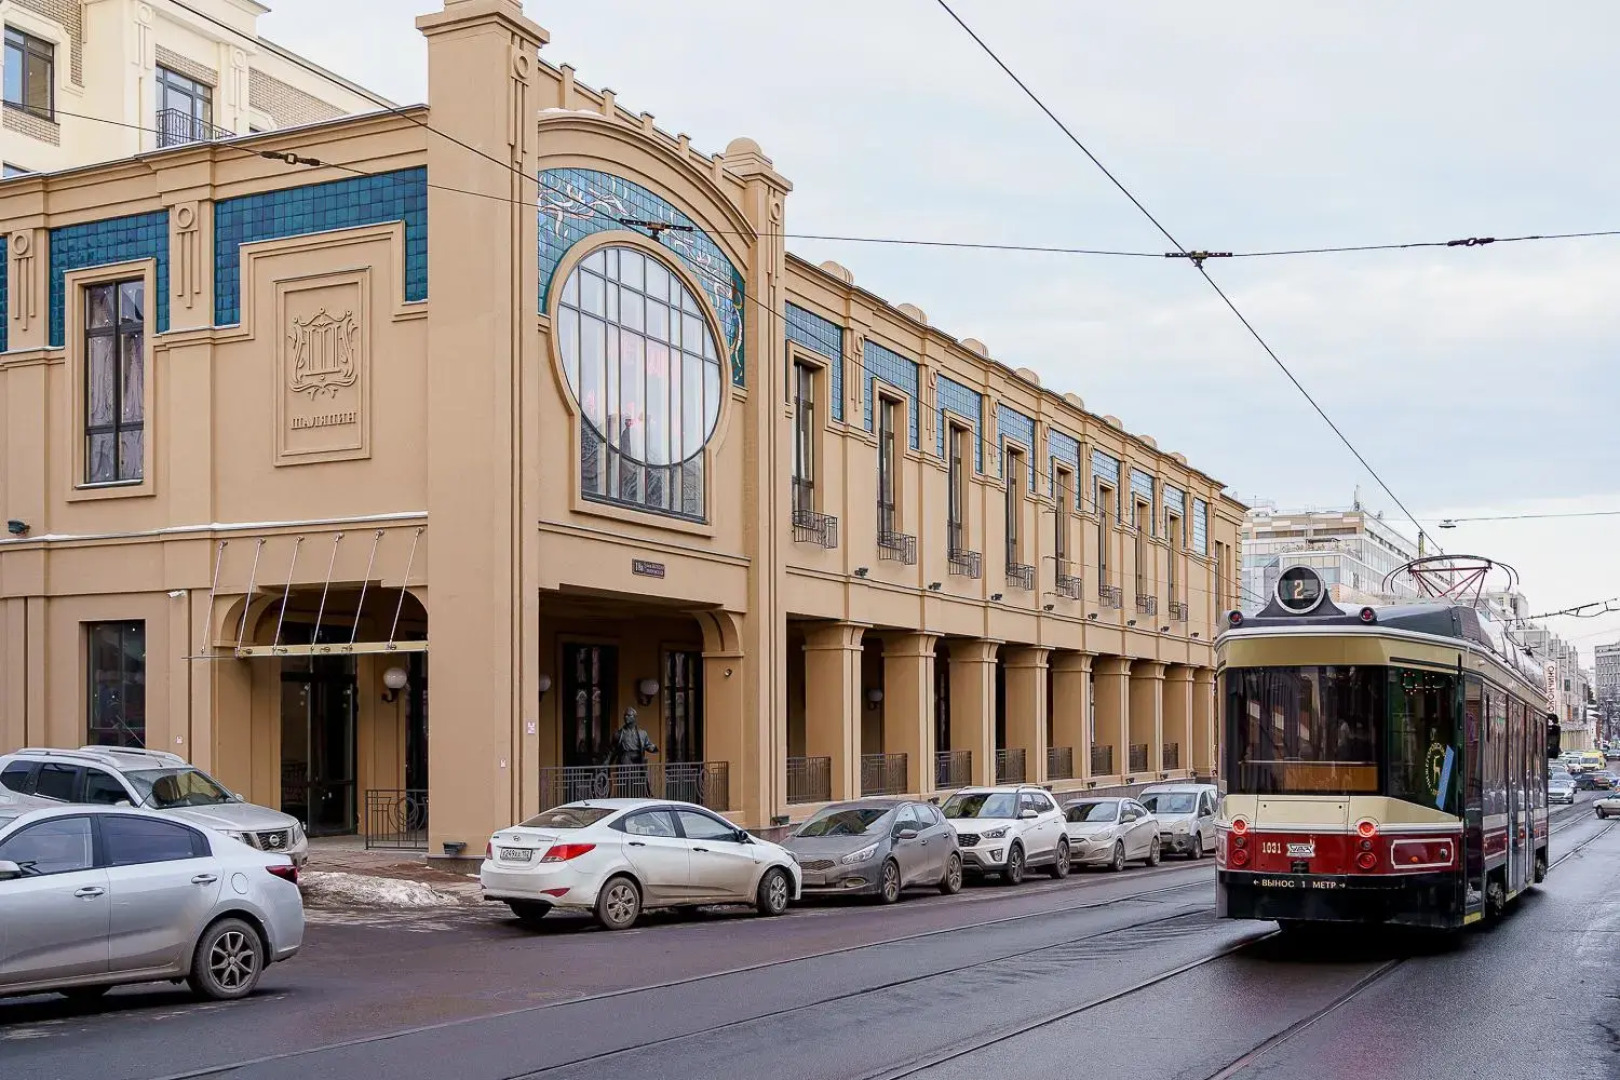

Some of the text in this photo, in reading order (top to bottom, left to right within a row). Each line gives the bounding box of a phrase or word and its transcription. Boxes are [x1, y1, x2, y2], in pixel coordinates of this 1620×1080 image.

[1294, 579, 1304, 599] 2
[1262, 841, 1282, 854] 1031
[1261, 879, 1337, 889] ВЫНОС 1 МЕТР
